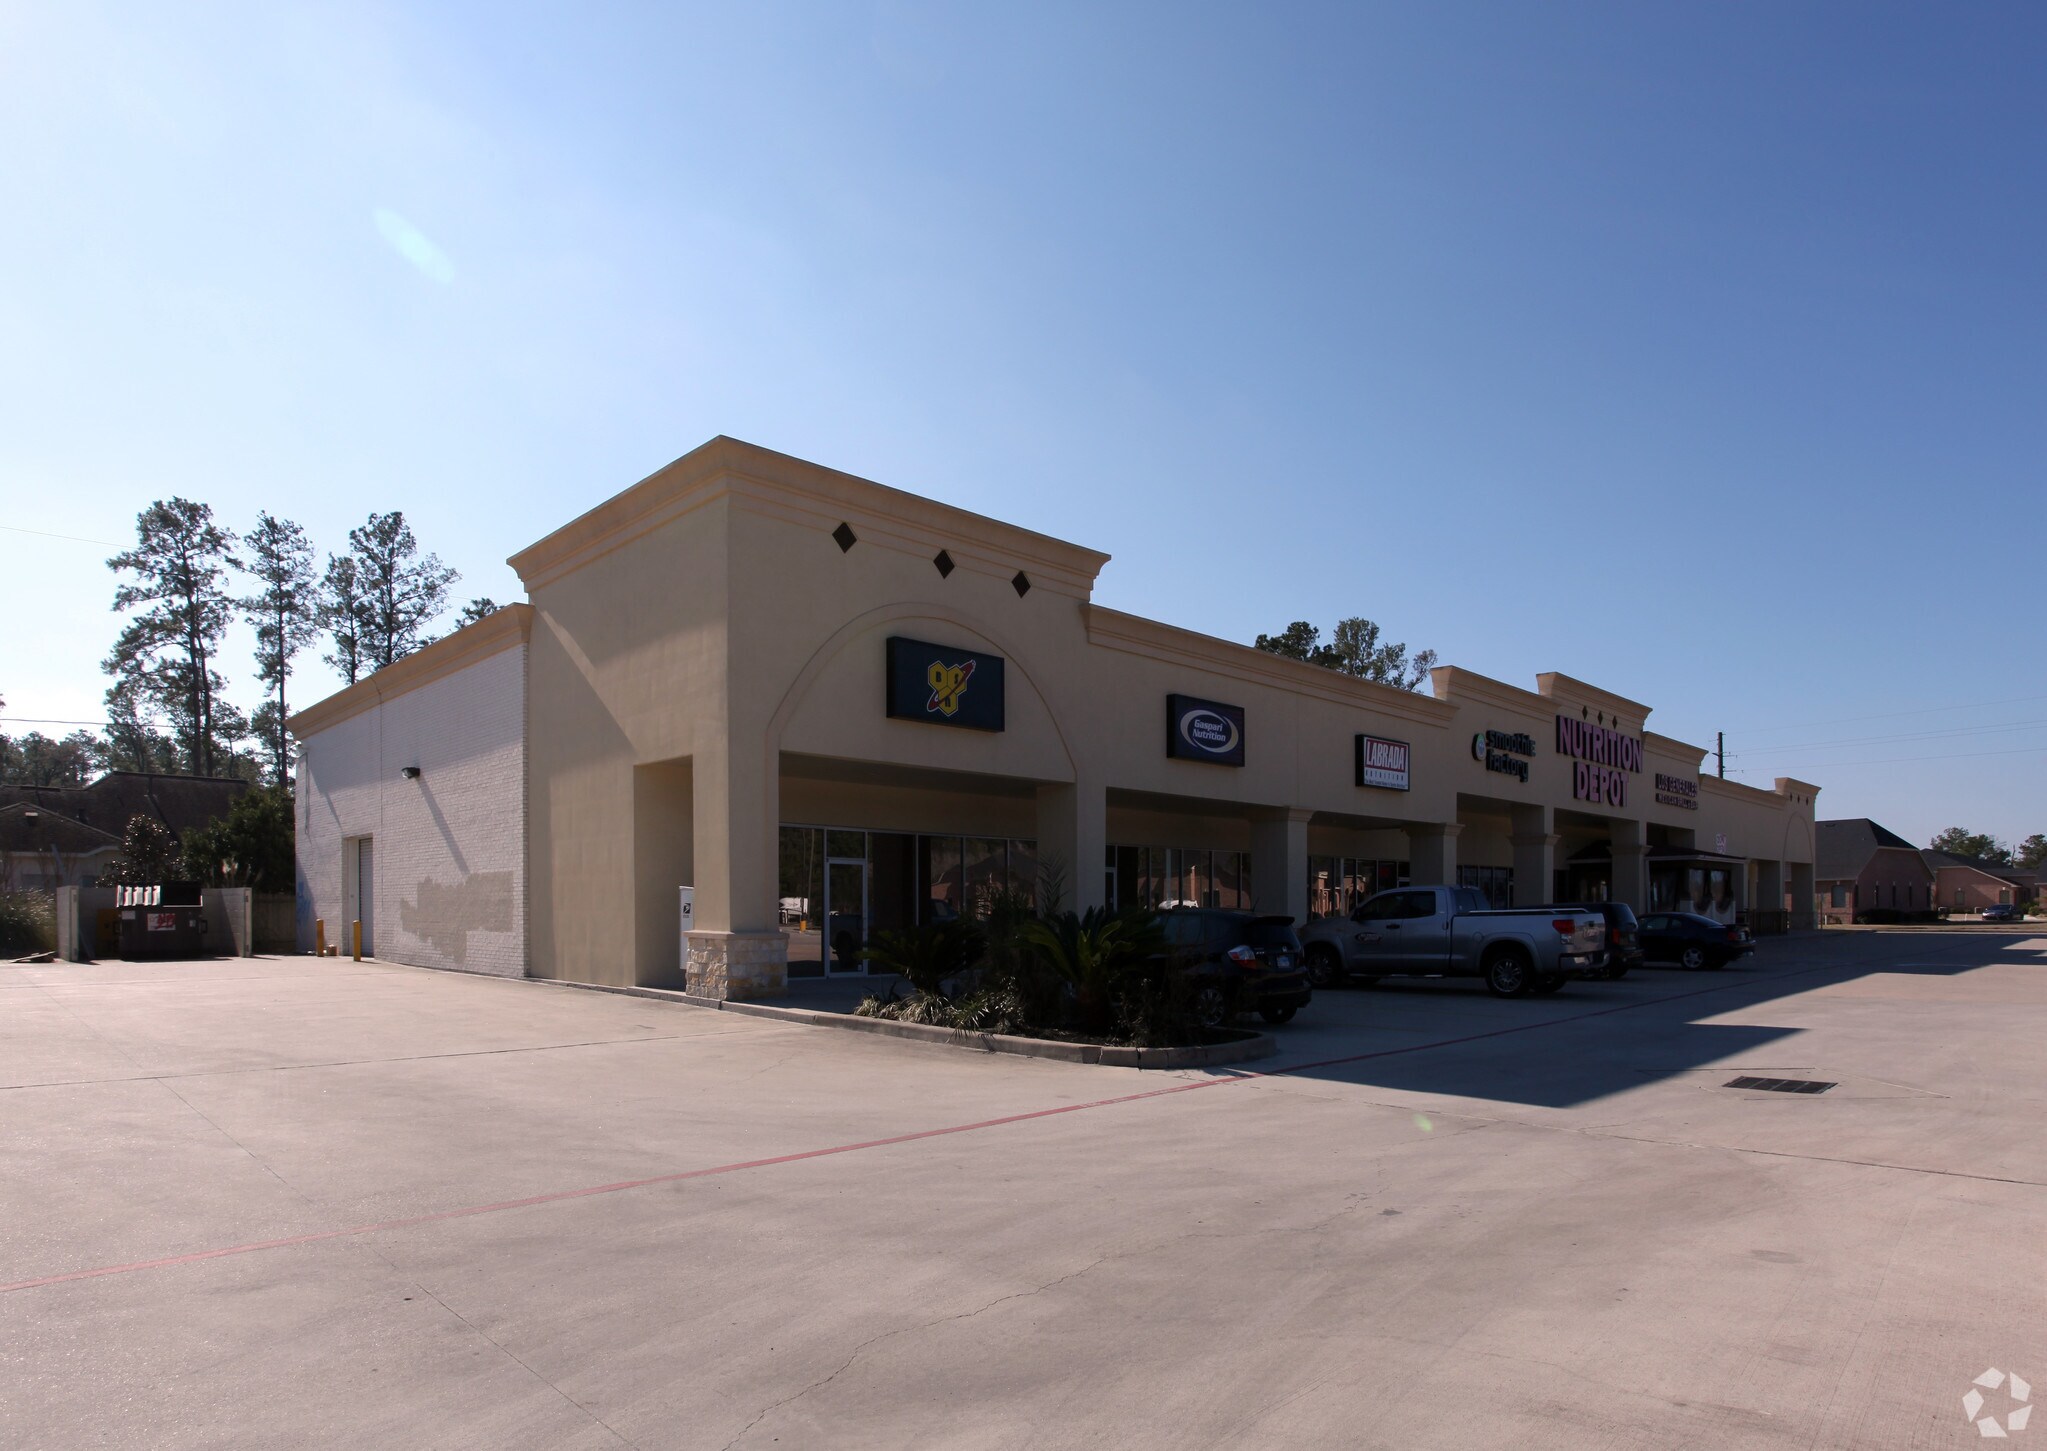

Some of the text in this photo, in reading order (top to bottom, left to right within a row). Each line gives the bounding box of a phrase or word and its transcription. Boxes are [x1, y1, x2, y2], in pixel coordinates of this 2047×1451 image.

[1192, 729, 1227, 742] Nutrition
[1194, 719, 1223, 732] Gaspari
[1366, 741, 1405, 770] LABRADA
[1556, 714, 1643, 774] NUTRITION
[1573, 762, 1630, 808] DEPOT
